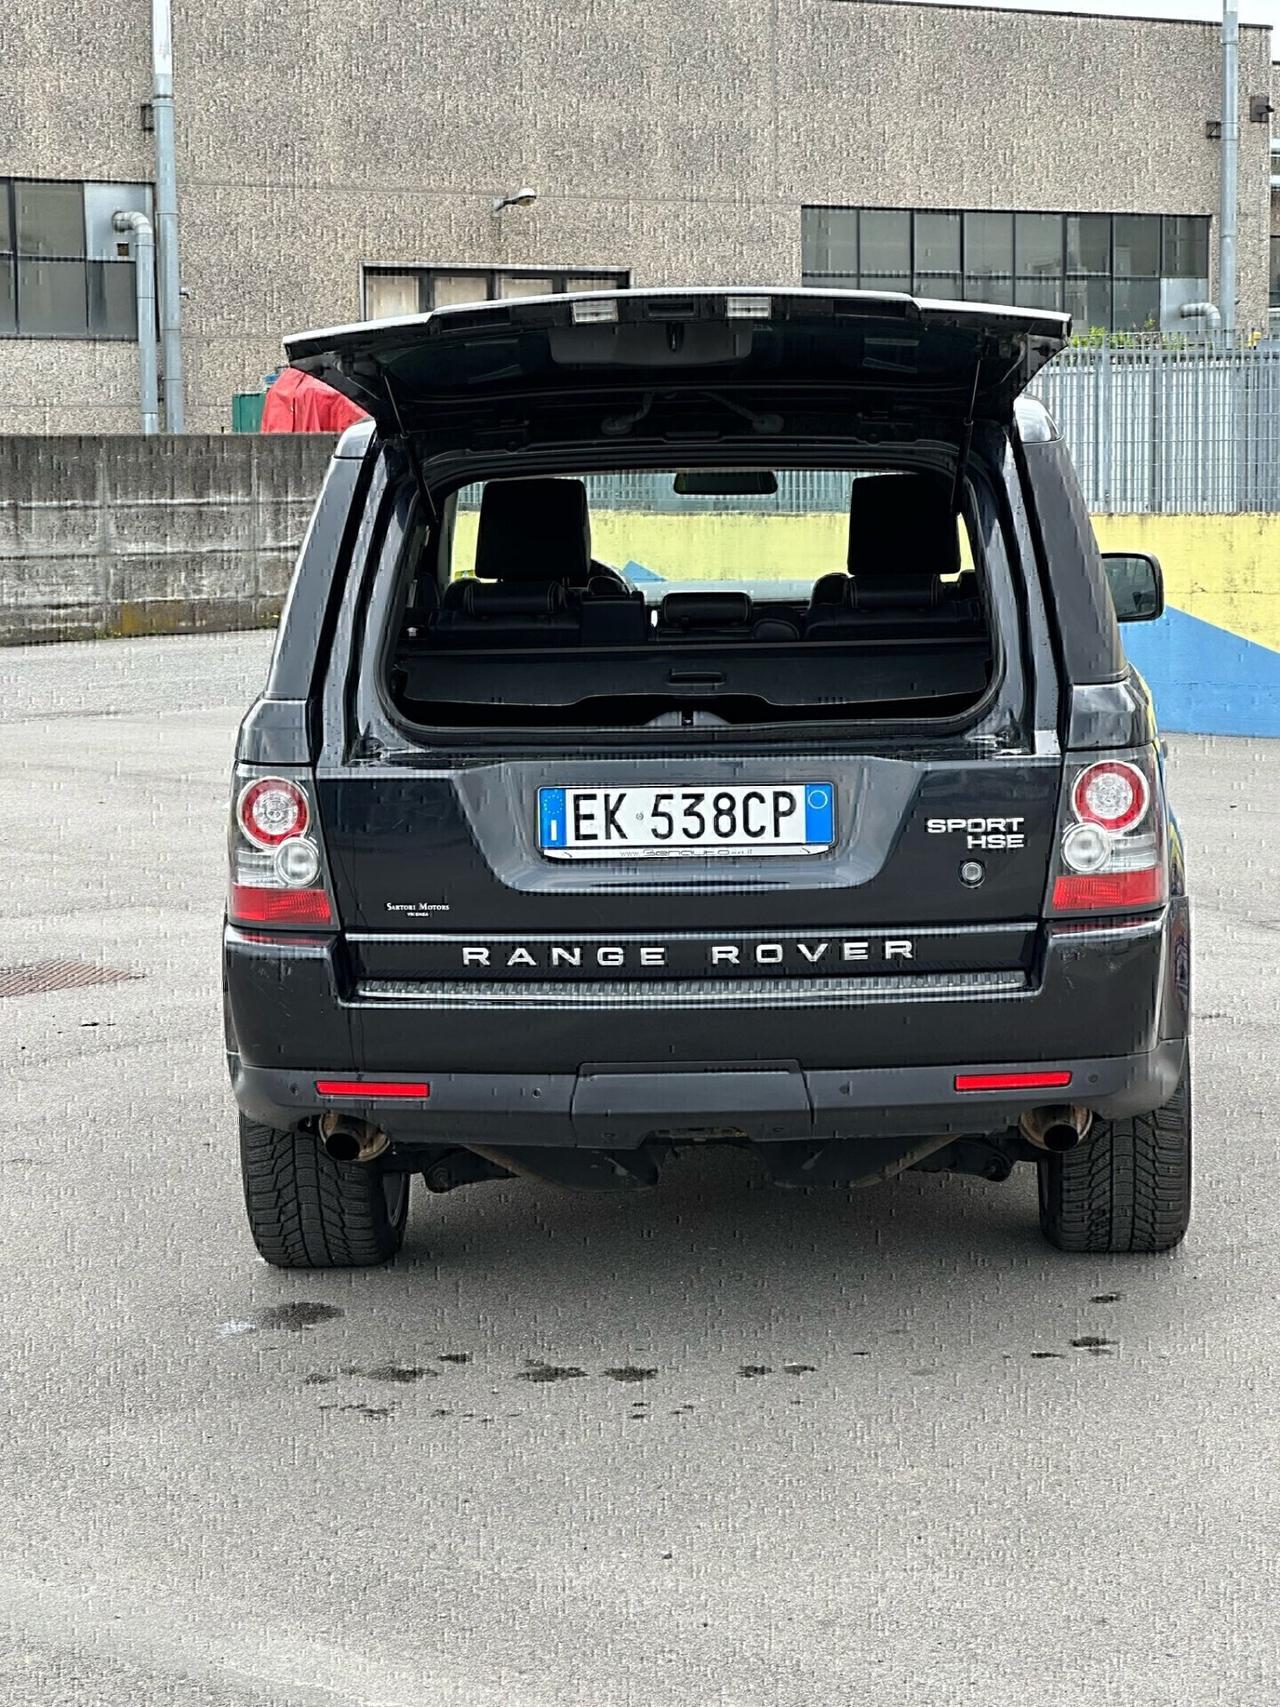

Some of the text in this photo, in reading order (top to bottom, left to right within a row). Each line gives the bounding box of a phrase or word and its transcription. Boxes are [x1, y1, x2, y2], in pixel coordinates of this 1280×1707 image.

[573, 790, 797, 841] EK 538CP
[926, 817, 1025, 833] SPORT
[966, 834, 1025, 849] HSE
[462, 940, 915, 967] RANGE ROVER
